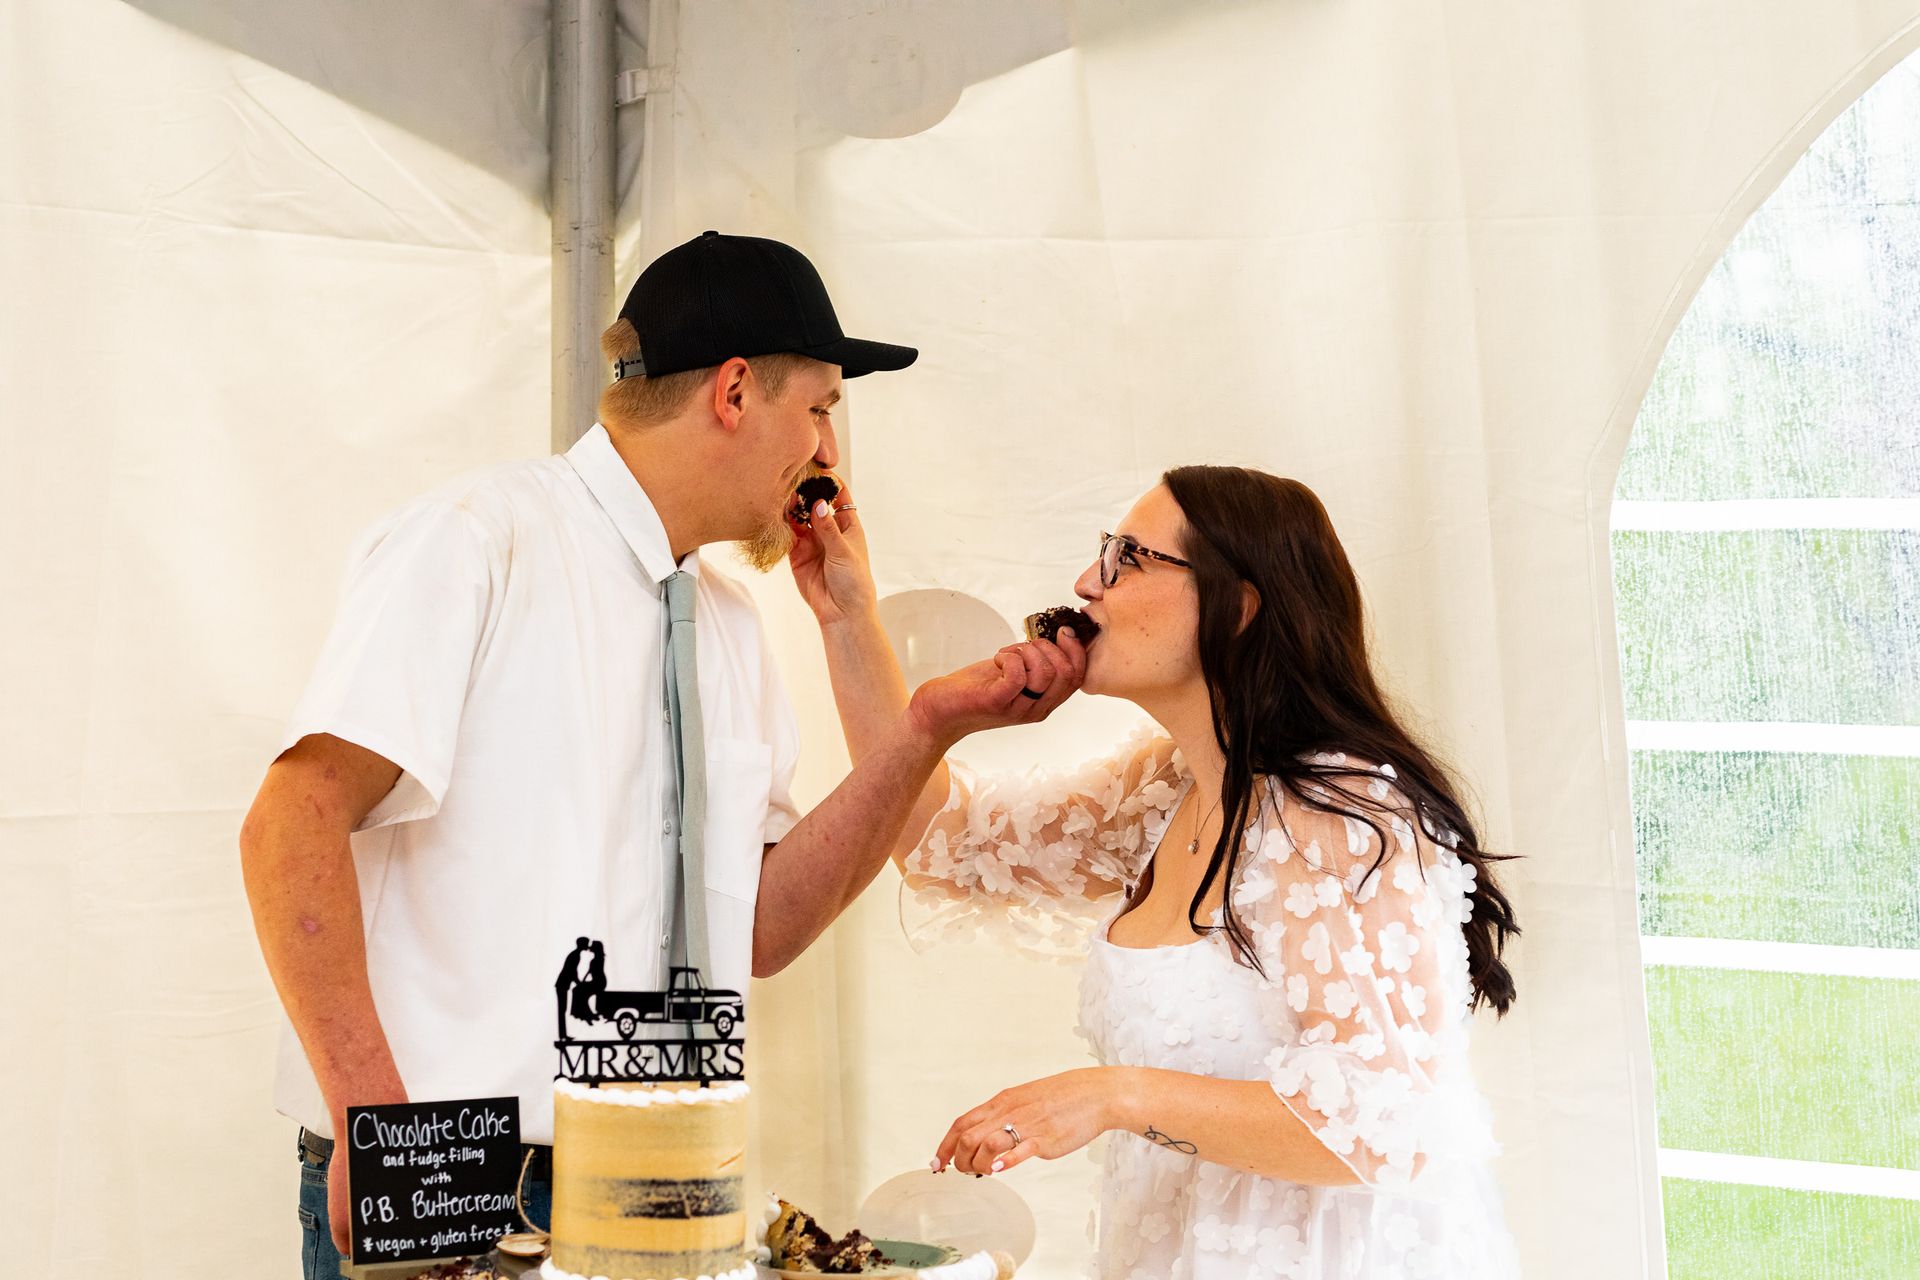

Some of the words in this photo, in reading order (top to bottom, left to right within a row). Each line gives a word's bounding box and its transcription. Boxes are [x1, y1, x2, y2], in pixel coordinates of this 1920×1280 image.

[353, 1112, 455, 1150] Chocolate
[458, 1107, 510, 1140] Cake
[383, 1153, 405, 1167] and
[408, 1150, 446, 1169] fudge
[447, 1147, 485, 1165] filling
[421, 1171, 452, 1186] with
[360, 1195, 399, 1225] P.B.
[412, 1190, 516, 1220] Buttercream
[430, 1229, 467, 1253] gluten
